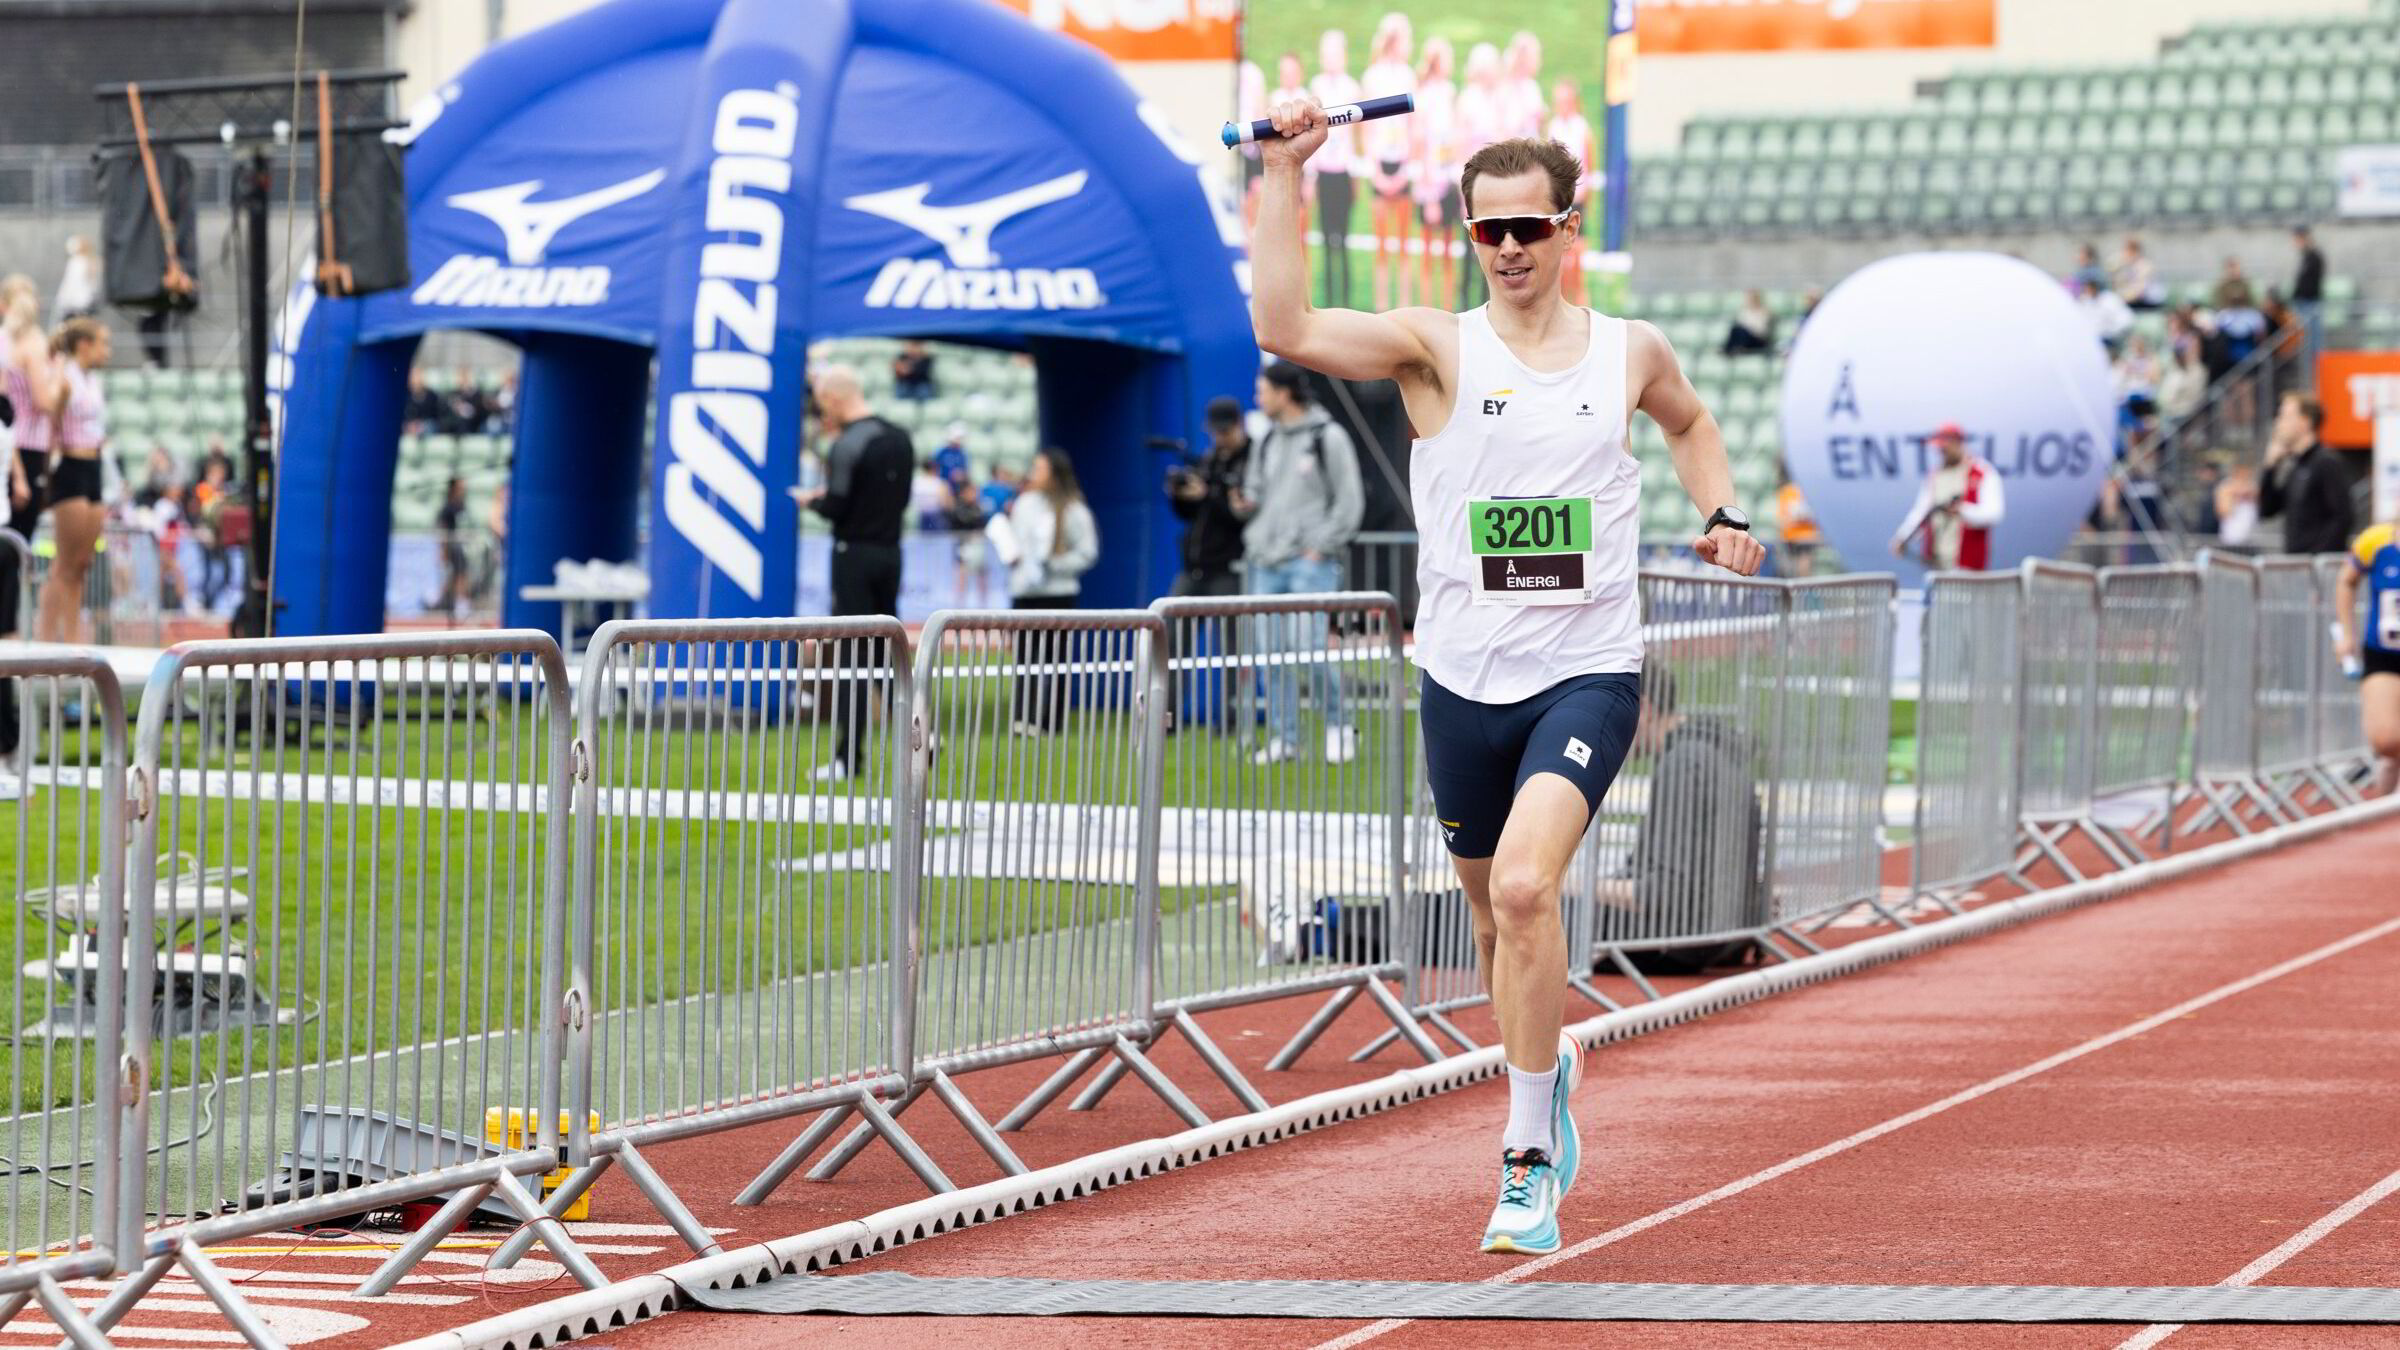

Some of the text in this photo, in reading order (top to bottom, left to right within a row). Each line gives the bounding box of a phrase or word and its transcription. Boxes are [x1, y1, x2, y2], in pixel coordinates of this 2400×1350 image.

[1829, 361, 1858, 418] Å
[1483, 400, 1507, 415] EY
[1484, 504, 1571, 549] 3201
[1506, 560, 1517, 574] Å
[1506, 576, 1560, 588] ENERGI
